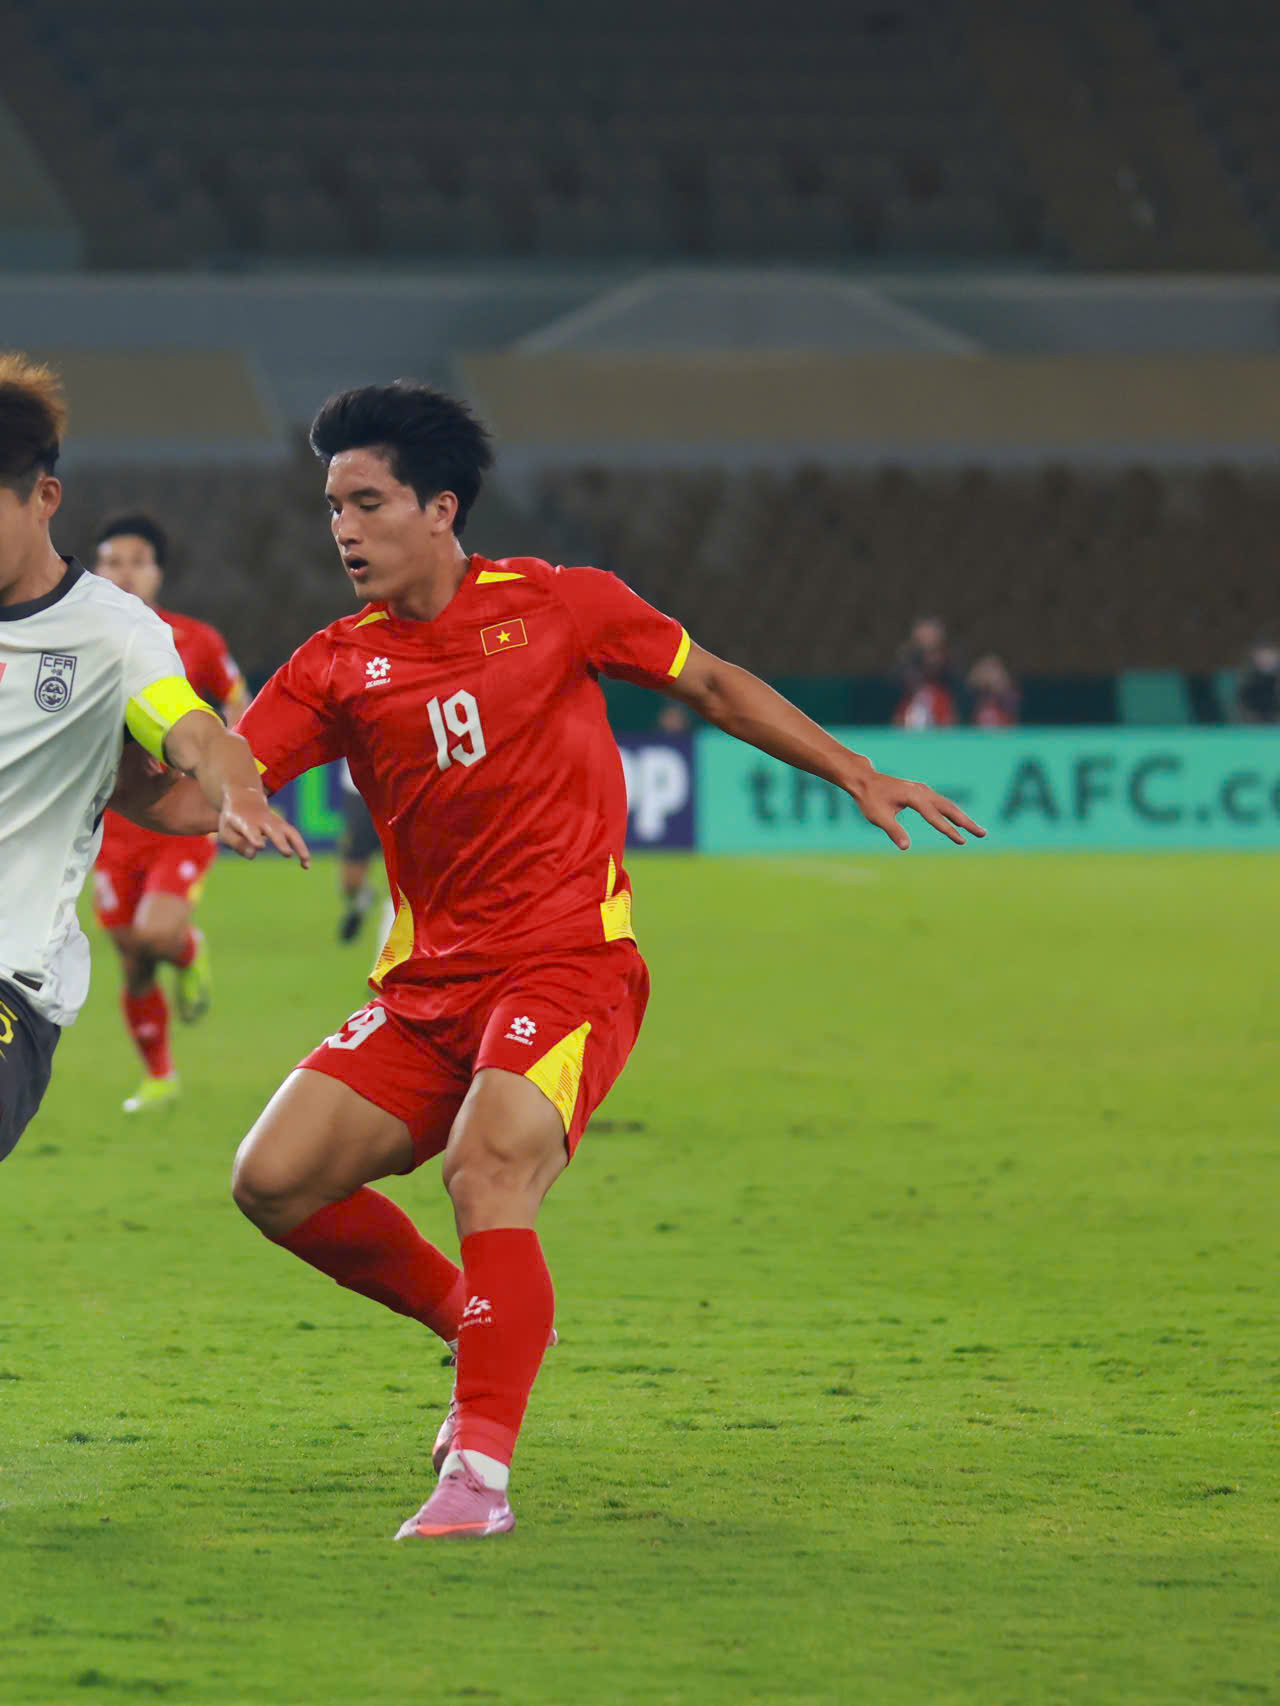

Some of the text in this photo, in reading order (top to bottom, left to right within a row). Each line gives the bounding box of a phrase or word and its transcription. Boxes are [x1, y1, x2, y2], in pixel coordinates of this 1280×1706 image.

[43, 656, 73, 670] CFA
[426, 689, 487, 771] 19
[748, 755, 1280, 828] th-AFC.c
